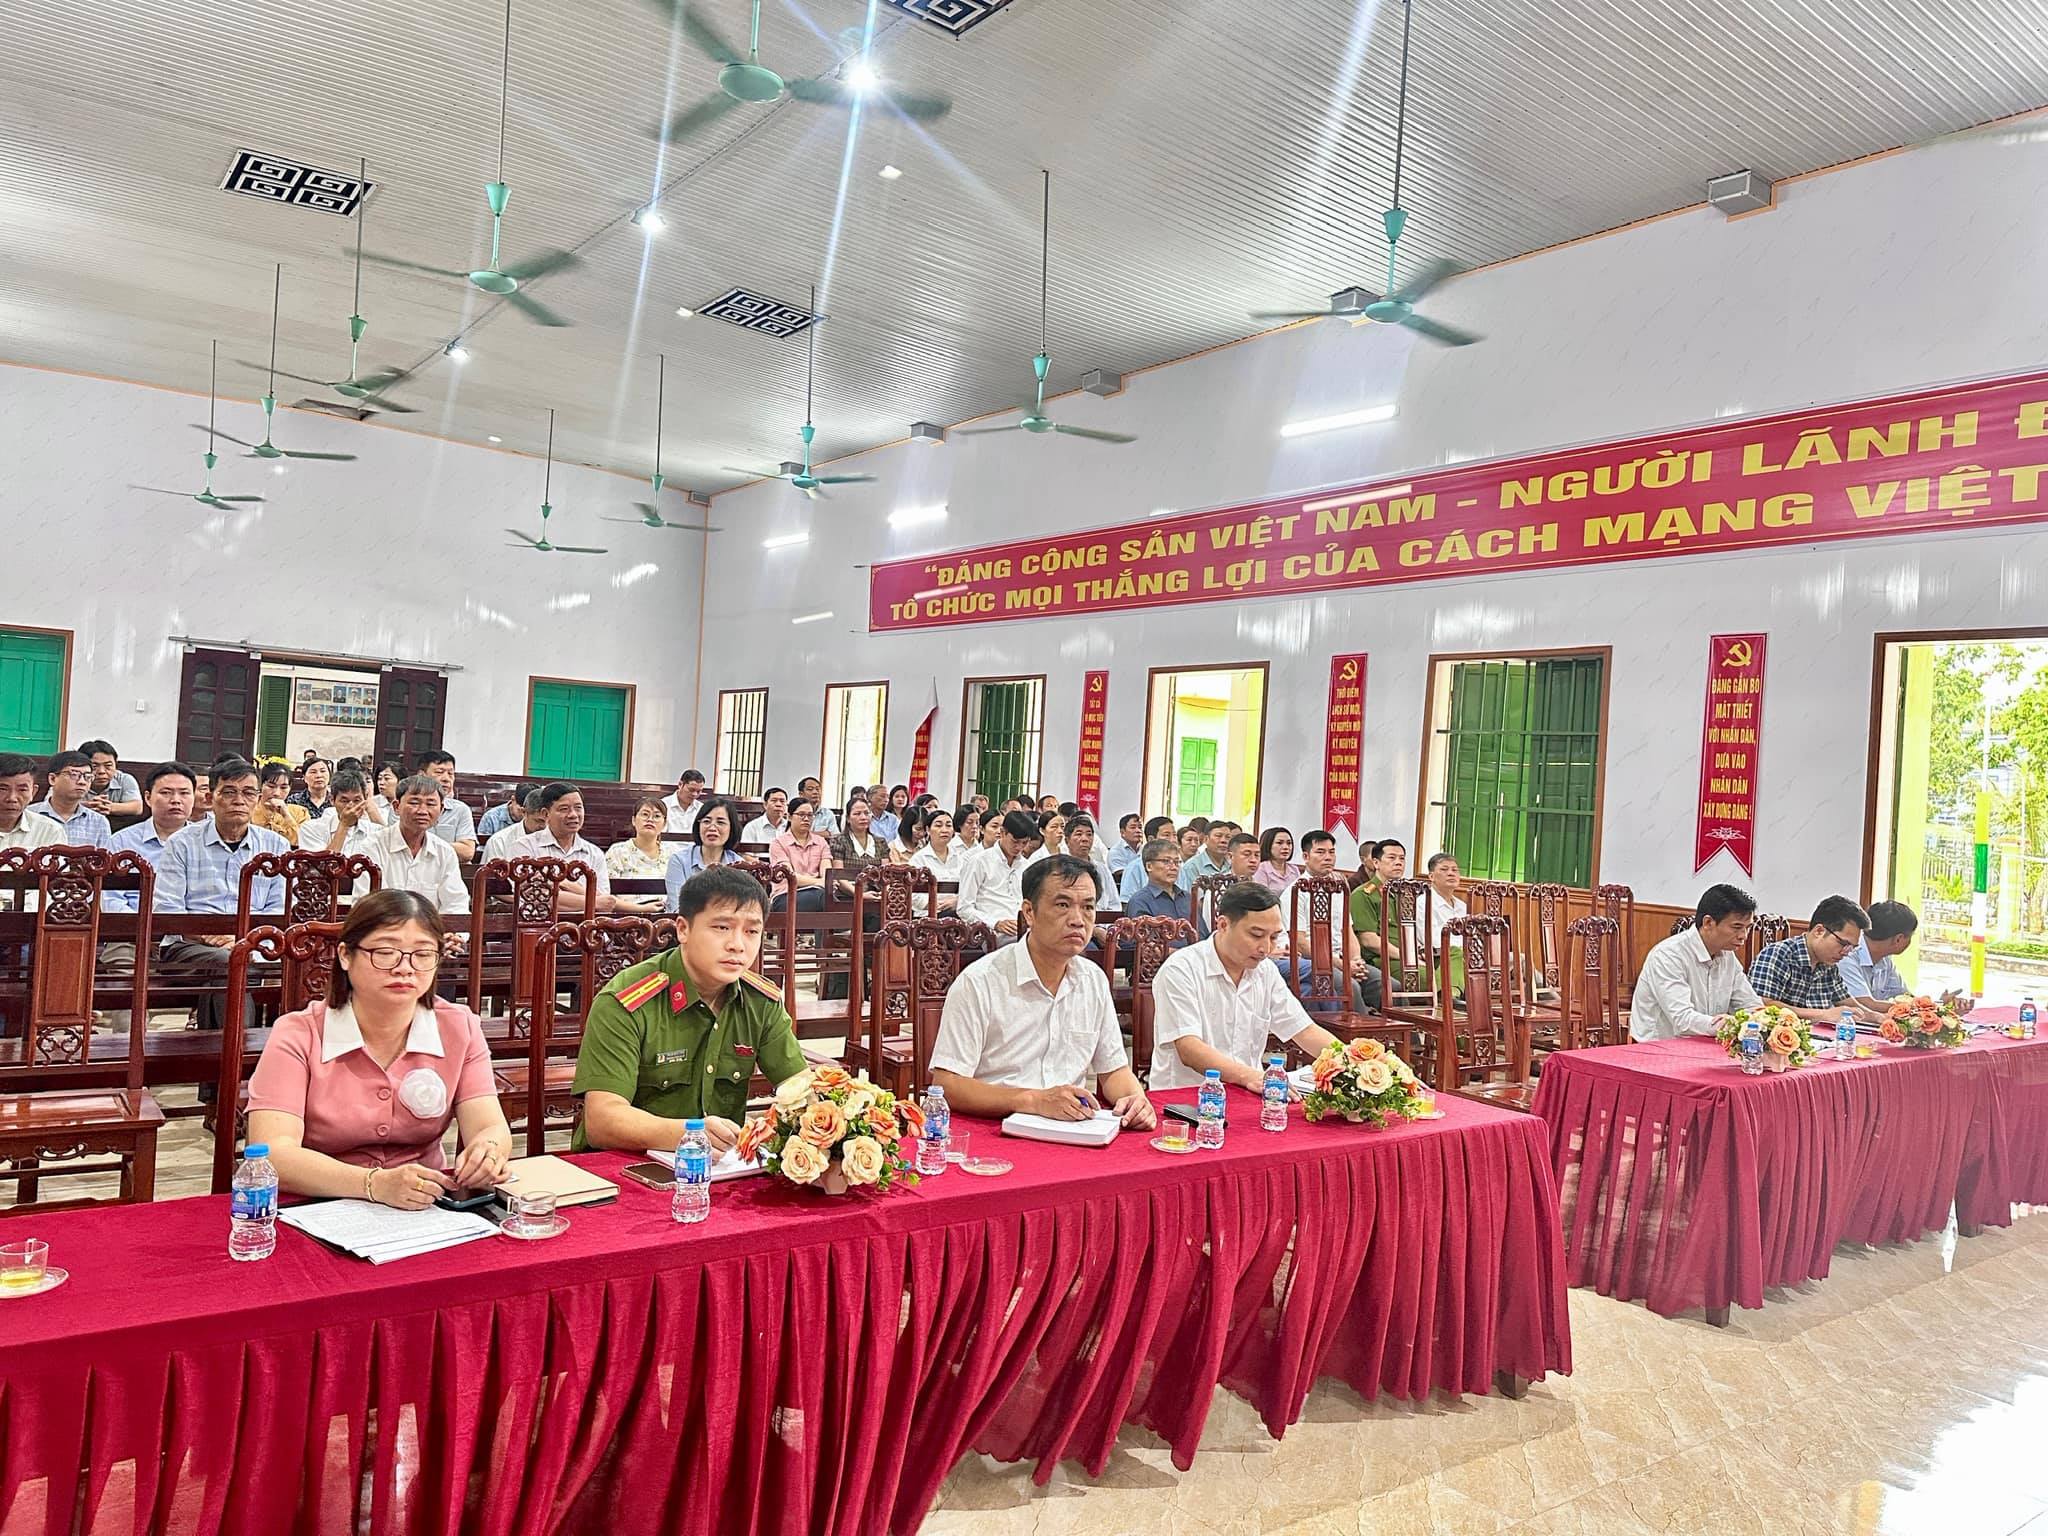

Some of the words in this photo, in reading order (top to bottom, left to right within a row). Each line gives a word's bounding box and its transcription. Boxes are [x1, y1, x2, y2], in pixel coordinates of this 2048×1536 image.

[926, 590, 995, 617] CHỨC
[1004, 584, 1062, 610] MỌI
[1073, 567, 1189, 603] THẮNG
[1202, 559, 1266, 591] LỢI
[1283, 542, 1380, 580] CỦA
[1399, 528, 1558, 567] CÁCH
[1583, 493, 1813, 546] MẠNG
[1845, 463, 2048, 519] VIỆT
[1021, 544, 1108, 576] CỘNG
[1119, 529, 1196, 562] SẢN
[1209, 515, 1301, 549] VIỆT
[1315, 493, 1436, 535] NAM
[1499, 449, 1713, 510] NGƯỜI
[1741, 410, 1979, 476] LÃNH
